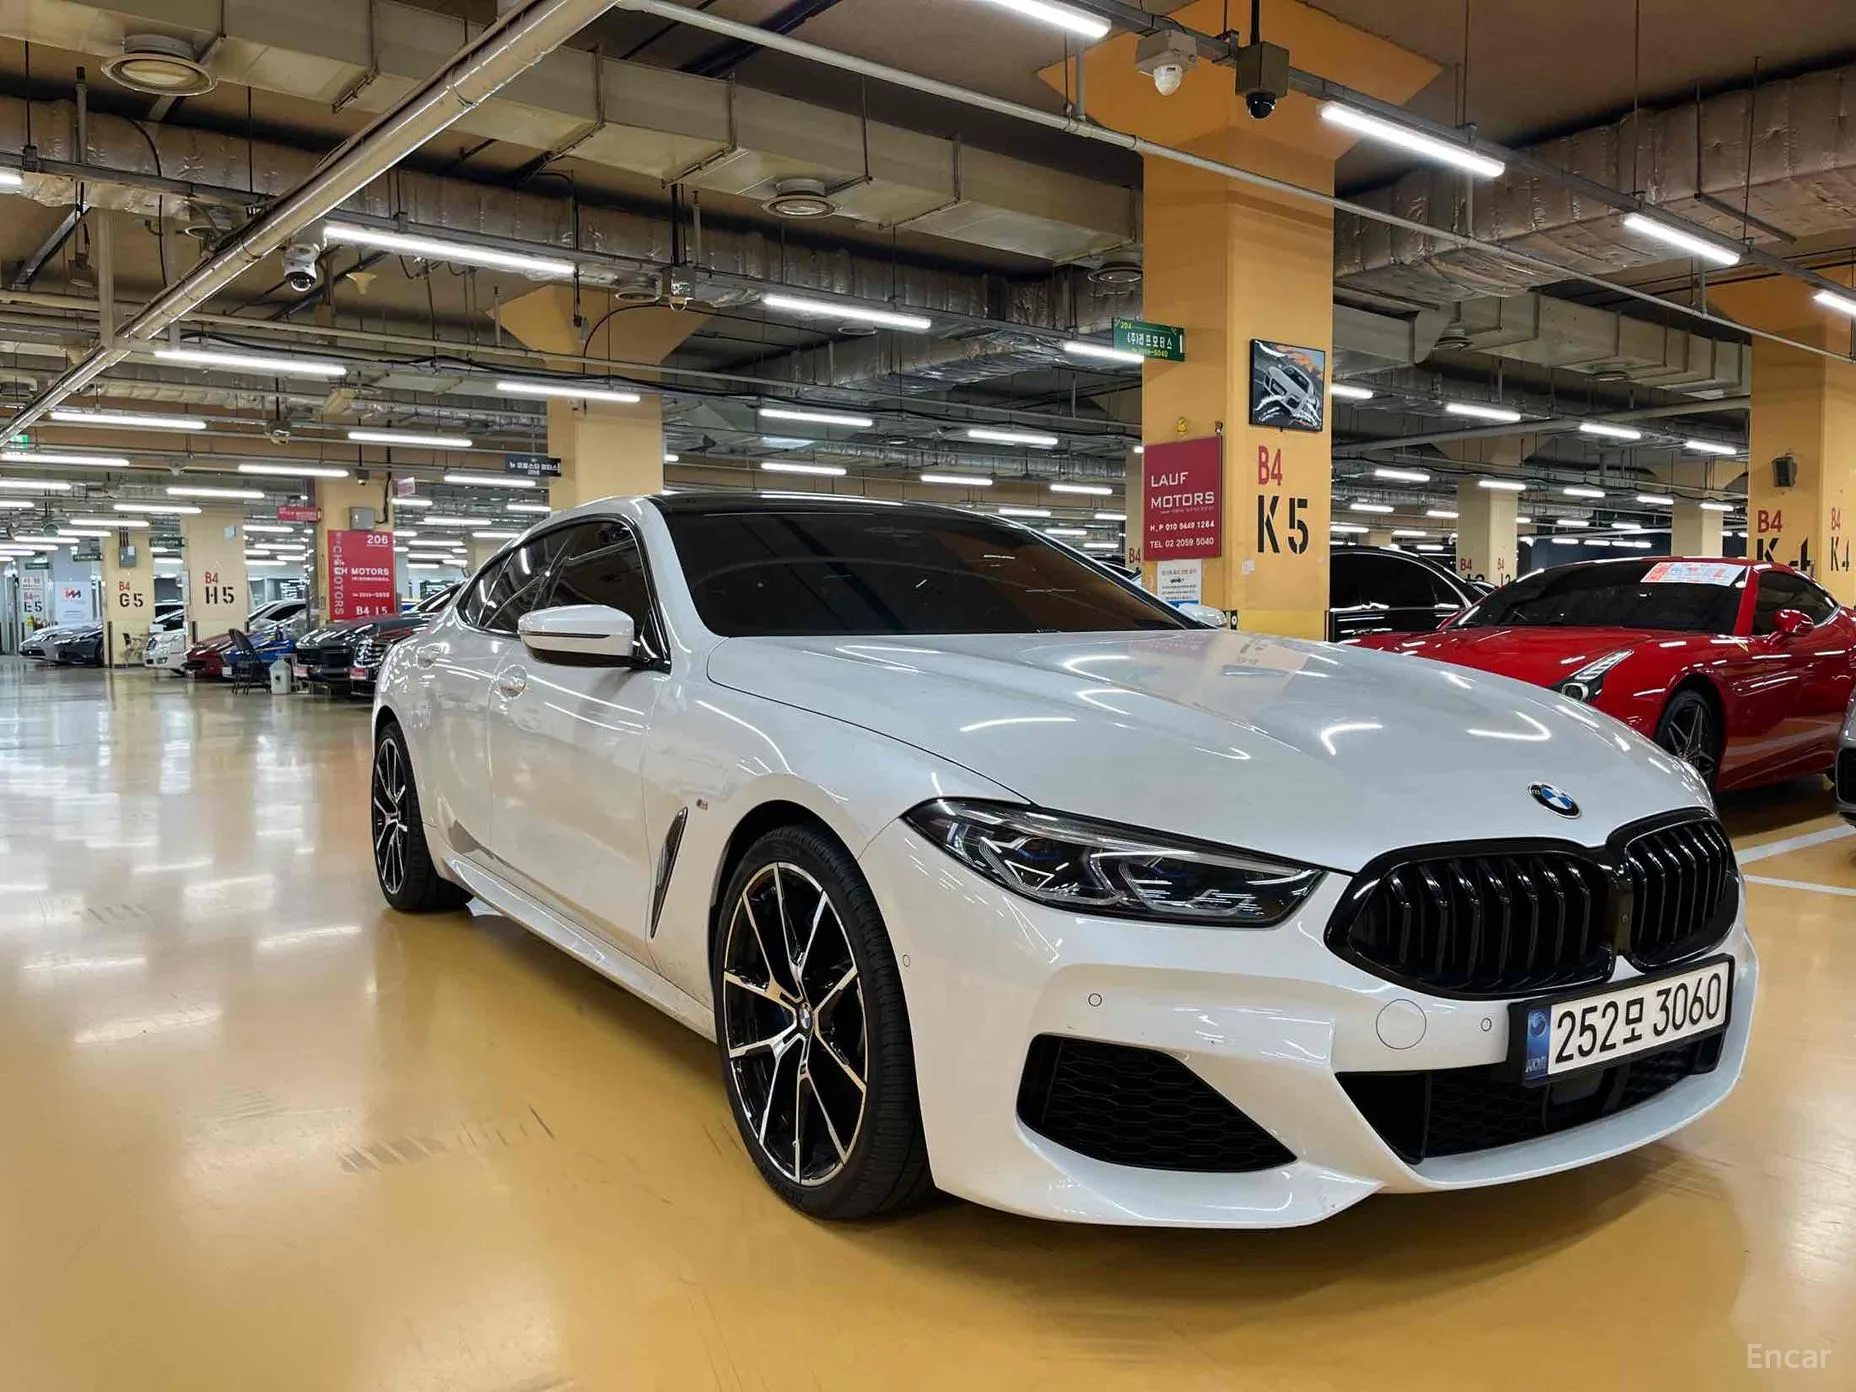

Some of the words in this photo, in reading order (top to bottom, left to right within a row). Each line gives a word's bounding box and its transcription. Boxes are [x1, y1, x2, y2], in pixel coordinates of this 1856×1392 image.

[1258, 445, 1283, 486] B4
[1151, 471, 1189, 488] LAUF
[1151, 491, 1215, 509] MOTORS
[1165, 522, 1177, 531] 010
[1757, 509, 1783, 533] B4
[1831, 507, 1841, 531] B4
[1150, 540, 1163, 549] TEL
[1165, 539, 1174, 548] 02
[1129, 547, 1141, 564] B4
[351, 567, 389, 576] MOTORS
[1460, 558, 1472, 571] B4
[205, 571, 219, 584] B4
[118, 581, 131, 592] B4
[1555, 997, 1645, 1064] 252모
[1653, 972, 1722, 1037] 3060
